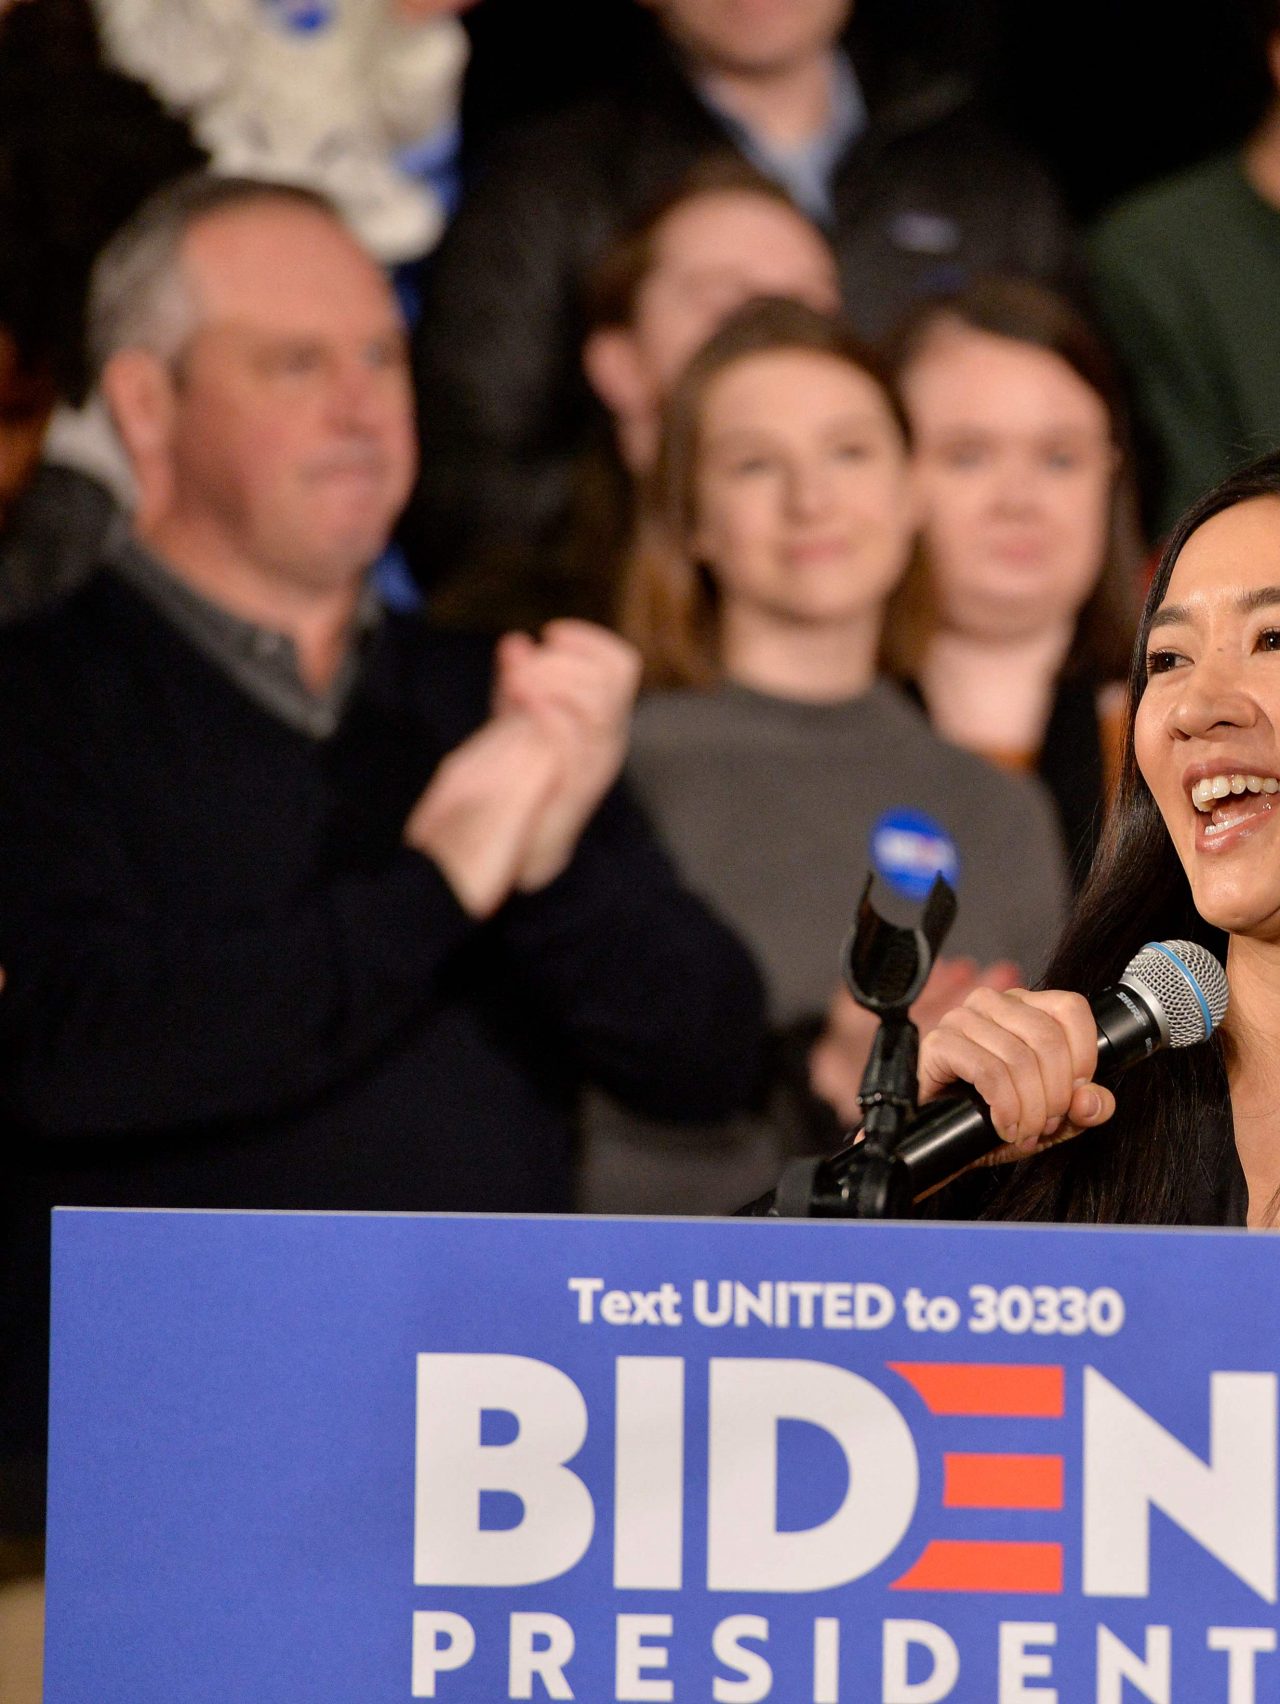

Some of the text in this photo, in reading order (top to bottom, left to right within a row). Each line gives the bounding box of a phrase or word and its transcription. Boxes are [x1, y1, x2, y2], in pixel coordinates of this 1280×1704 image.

[1116, 991, 1145, 1024] SHURE
[568, 1277, 1127, 1336] Text UNITED to 30330
[414, 1352, 1279, 1602] BIDEN
[411, 1610, 1278, 1704] PRESIDENT
